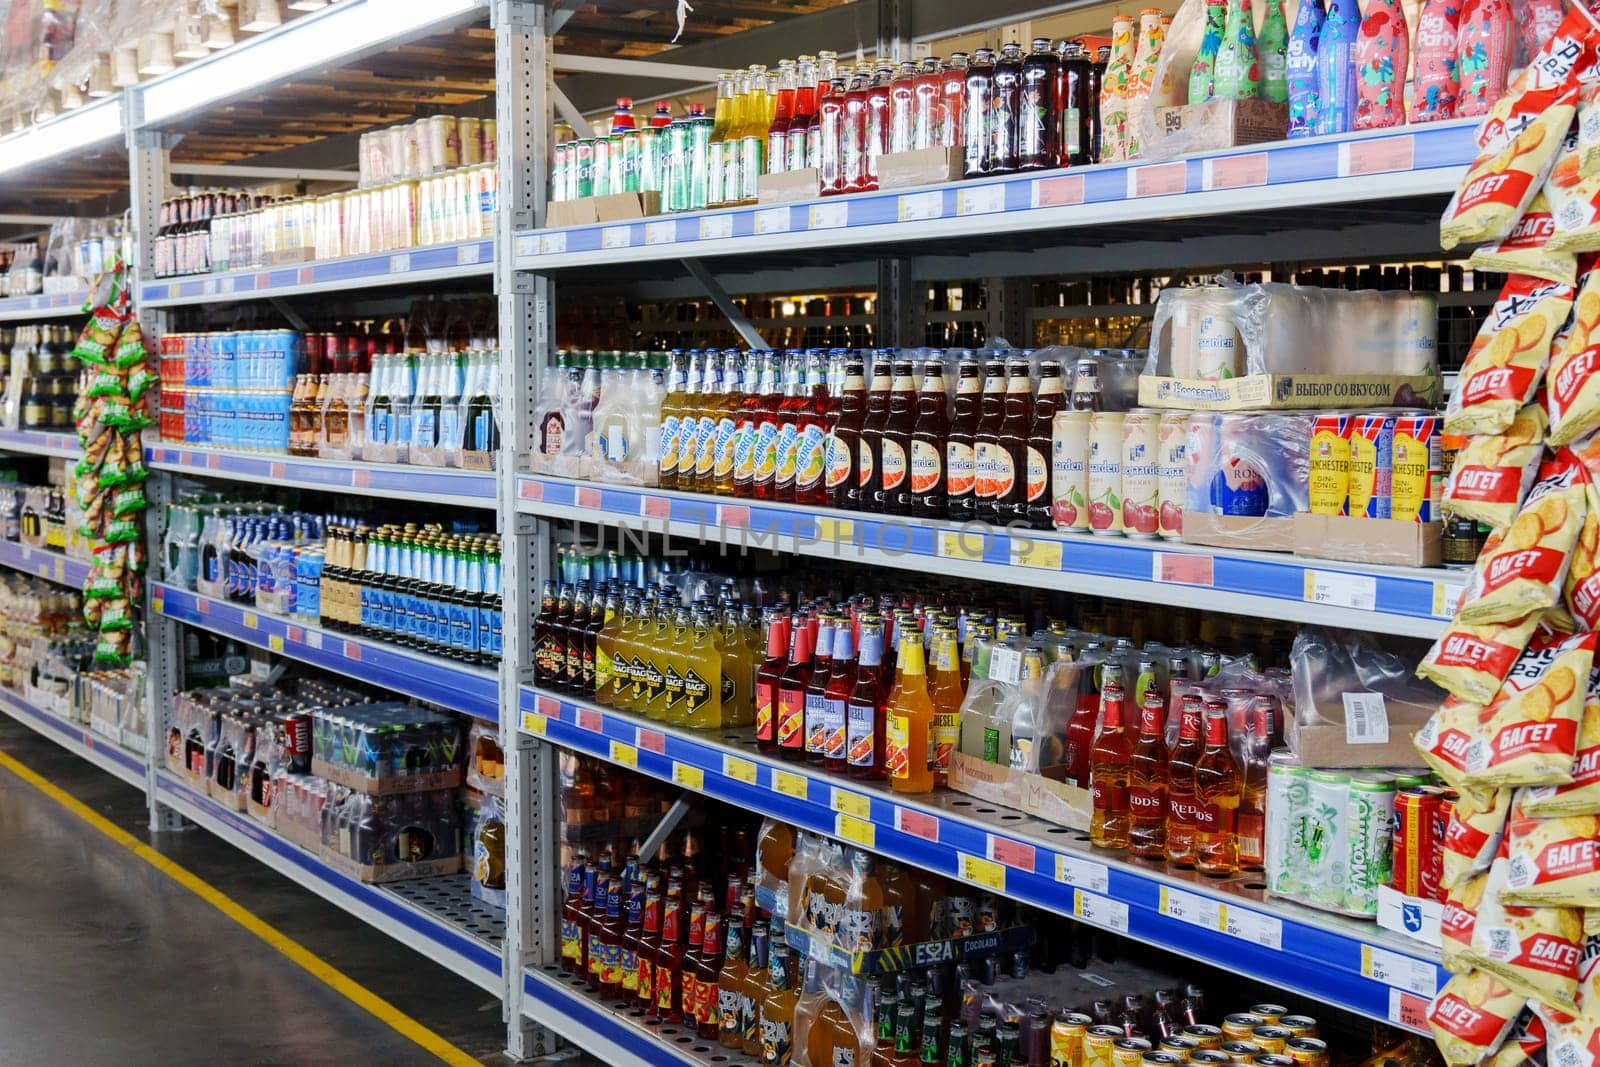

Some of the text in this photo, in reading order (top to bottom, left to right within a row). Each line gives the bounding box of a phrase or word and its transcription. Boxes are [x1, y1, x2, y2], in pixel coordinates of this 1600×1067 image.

[1420, 14, 1445, 31] Big
[1417, 32, 1459, 48] Party
[1165, 111, 1182, 130] Big
[1463, 174, 1510, 202] БАГЕТ
[1512, 216, 1555, 240] БАГЕ
[1468, 368, 1514, 395] БАГЕТ
[1556, 349, 1597, 398] БАГЕТ
[1296, 383, 1391, 397] ВЫБОР СО ВКУСОМ
[1459, 470, 1504, 490] БАГЕТ
[1490, 551, 1542, 582] БАГЕТ
[1446, 636, 1497, 662] БАГЕТ
[1501, 723, 1557, 751] БАГЕТ
[1437, 998, 1483, 1029] БАГЕТ
